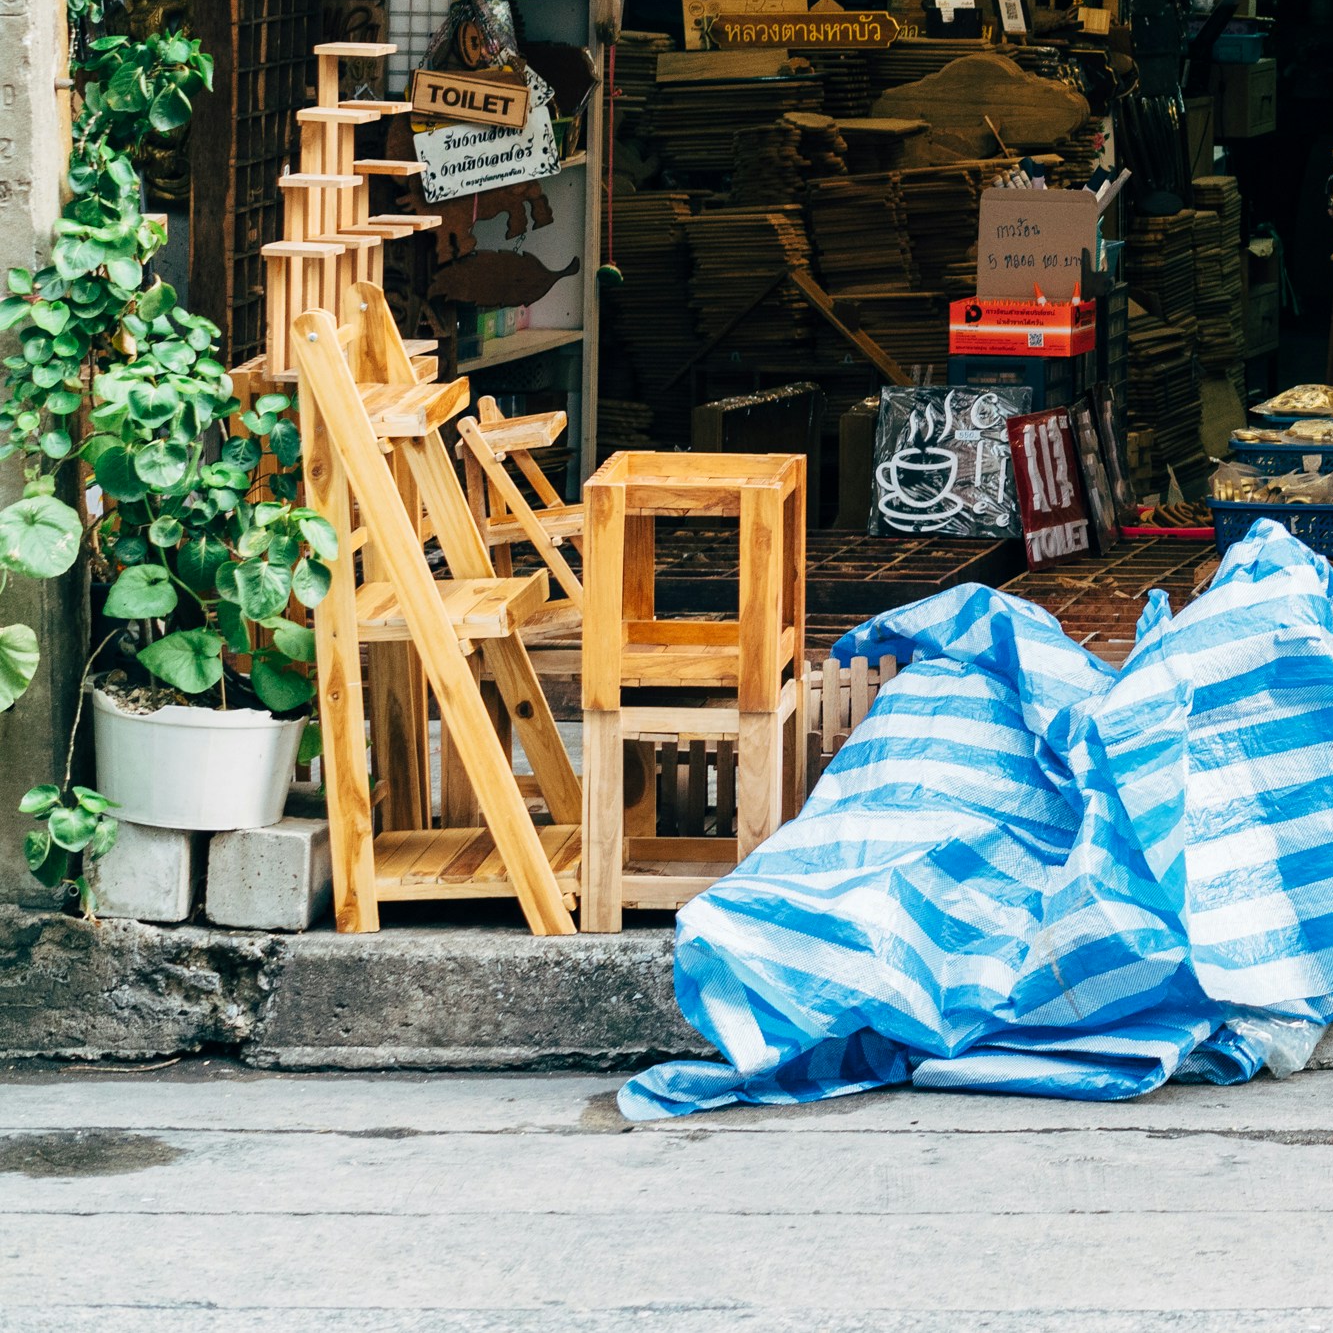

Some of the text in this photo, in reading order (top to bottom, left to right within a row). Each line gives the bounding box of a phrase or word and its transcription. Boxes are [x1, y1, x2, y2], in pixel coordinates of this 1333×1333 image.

[724, 15, 882, 43] หลวงตามหาบัว
[426, 79, 515, 116] TOILET
[996, 217, 1041, 239] กาวร้อน
